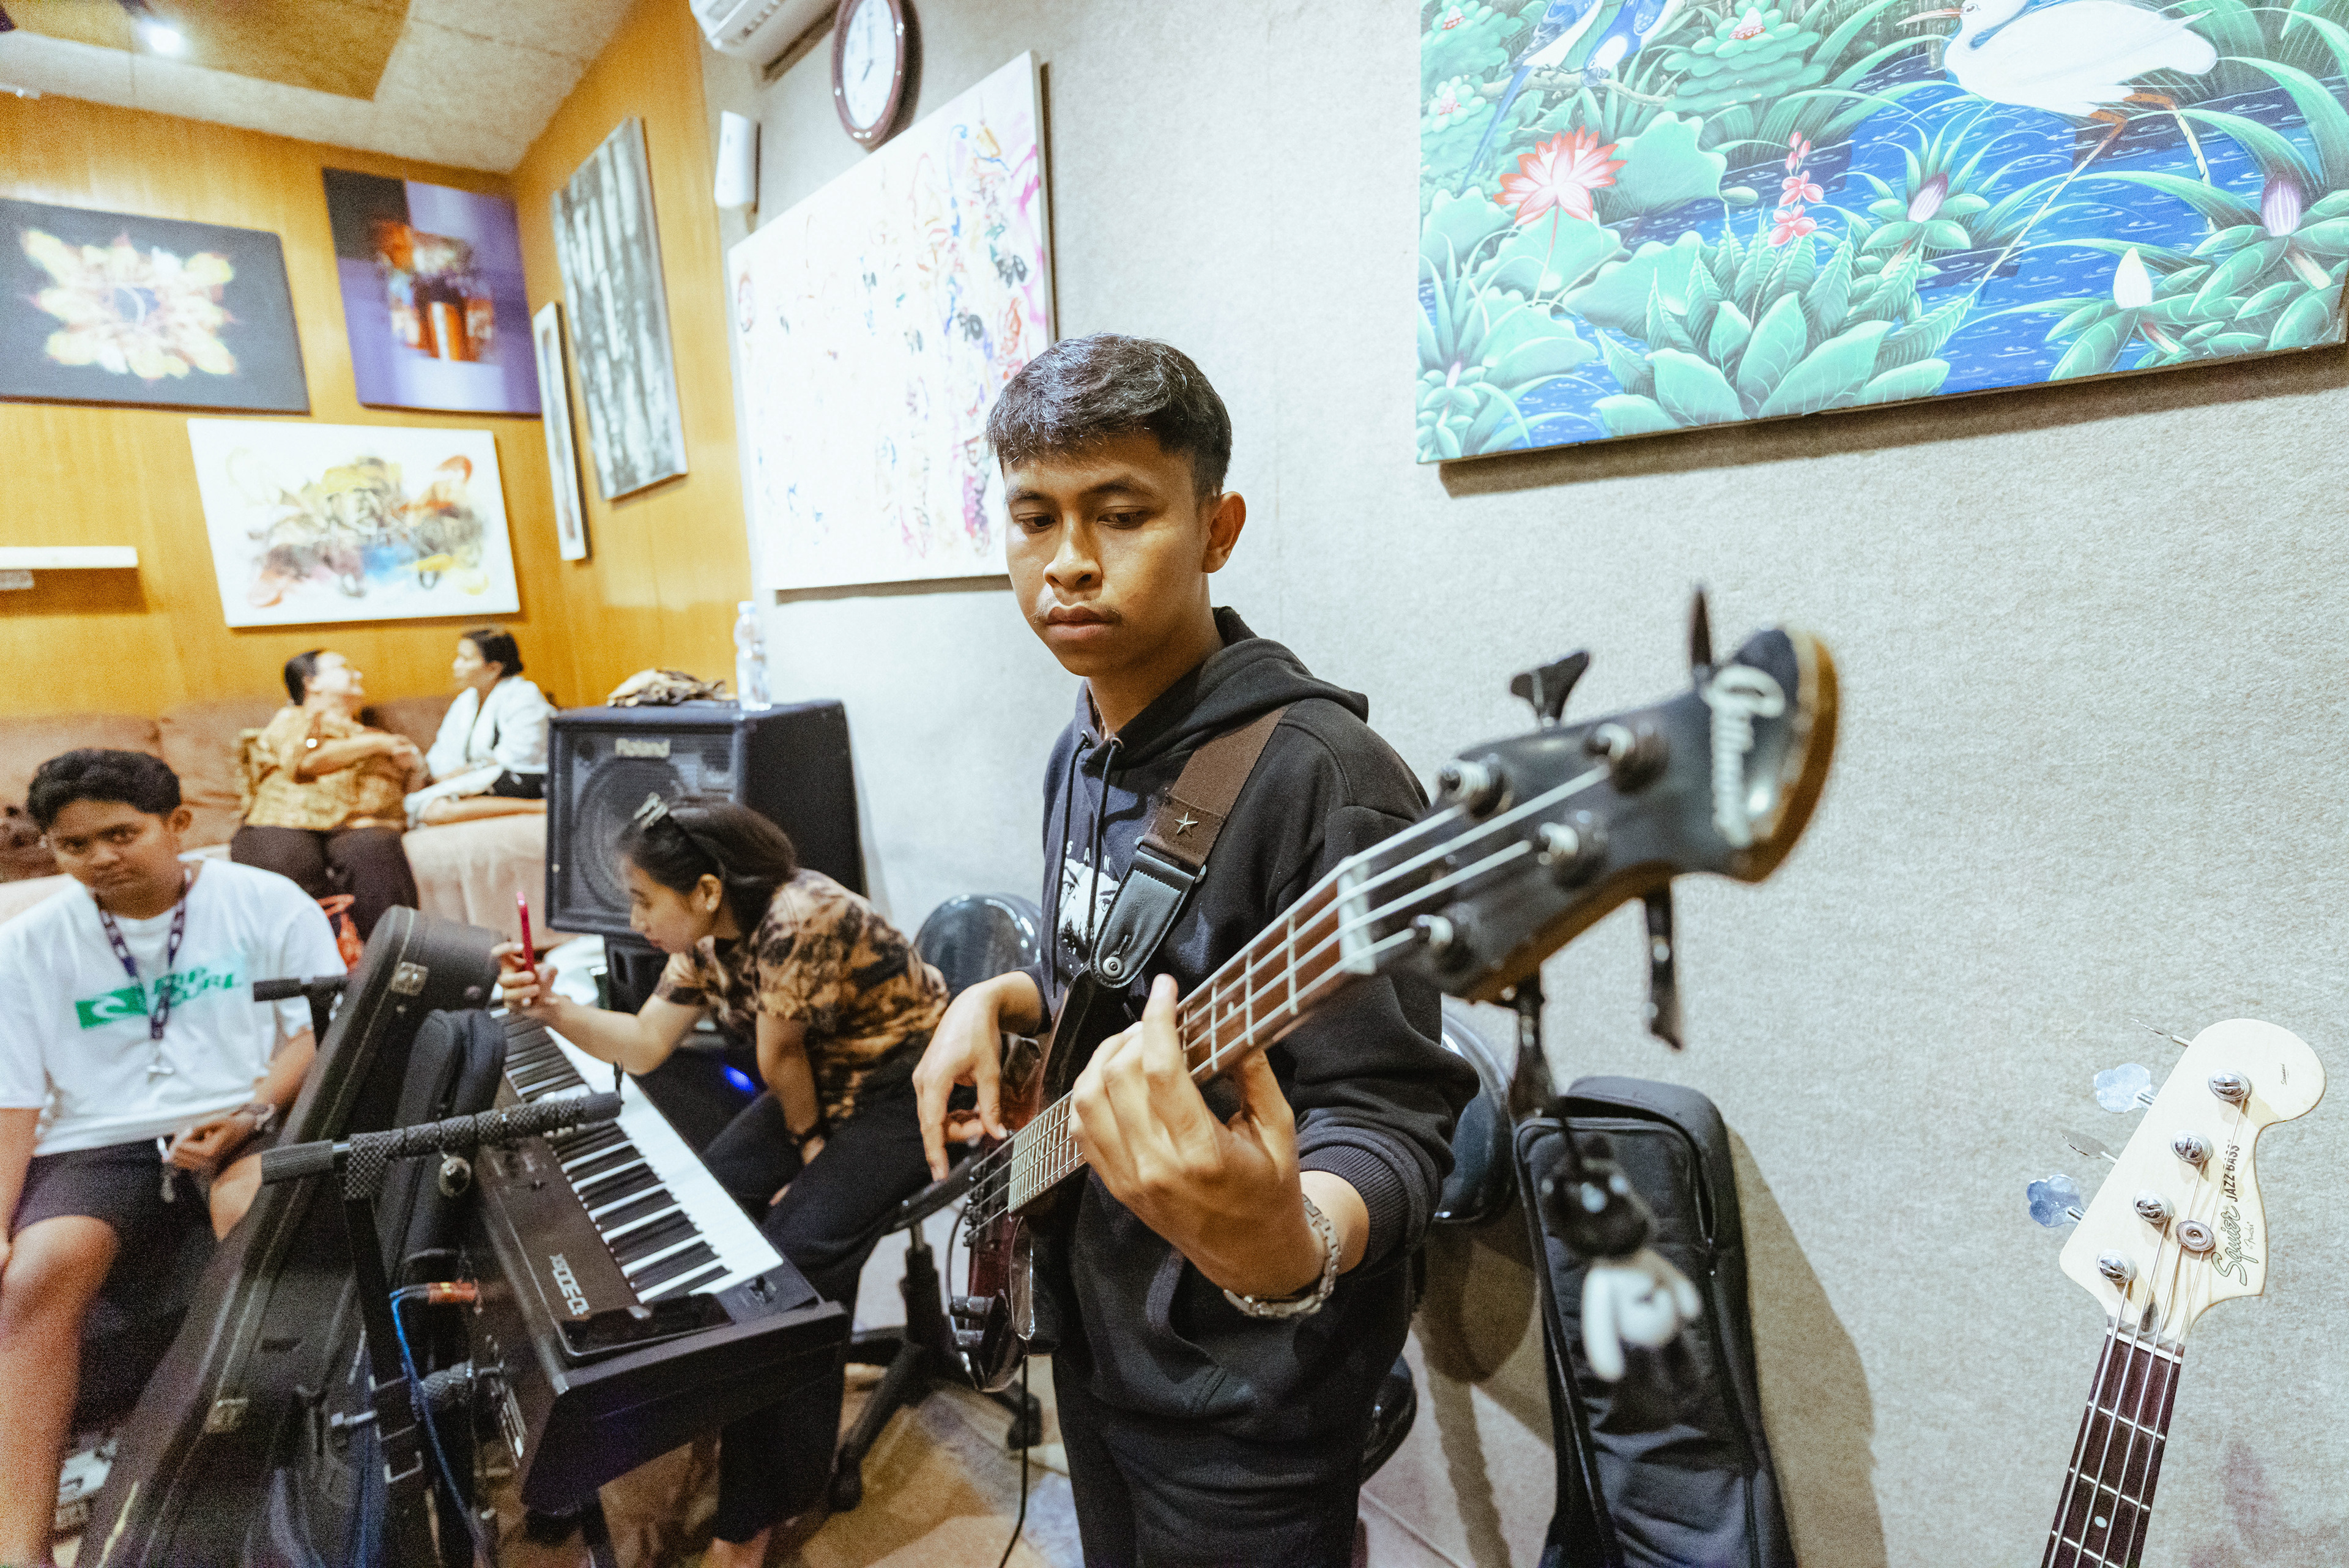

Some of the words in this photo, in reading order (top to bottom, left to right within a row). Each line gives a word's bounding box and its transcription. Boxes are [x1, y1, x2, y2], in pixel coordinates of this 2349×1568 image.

[2223, 1143, 2240, 1172] BASS
[2223, 1172, 2239, 1203] JAZZ
[2211, 1205, 2258, 1287] Squier
